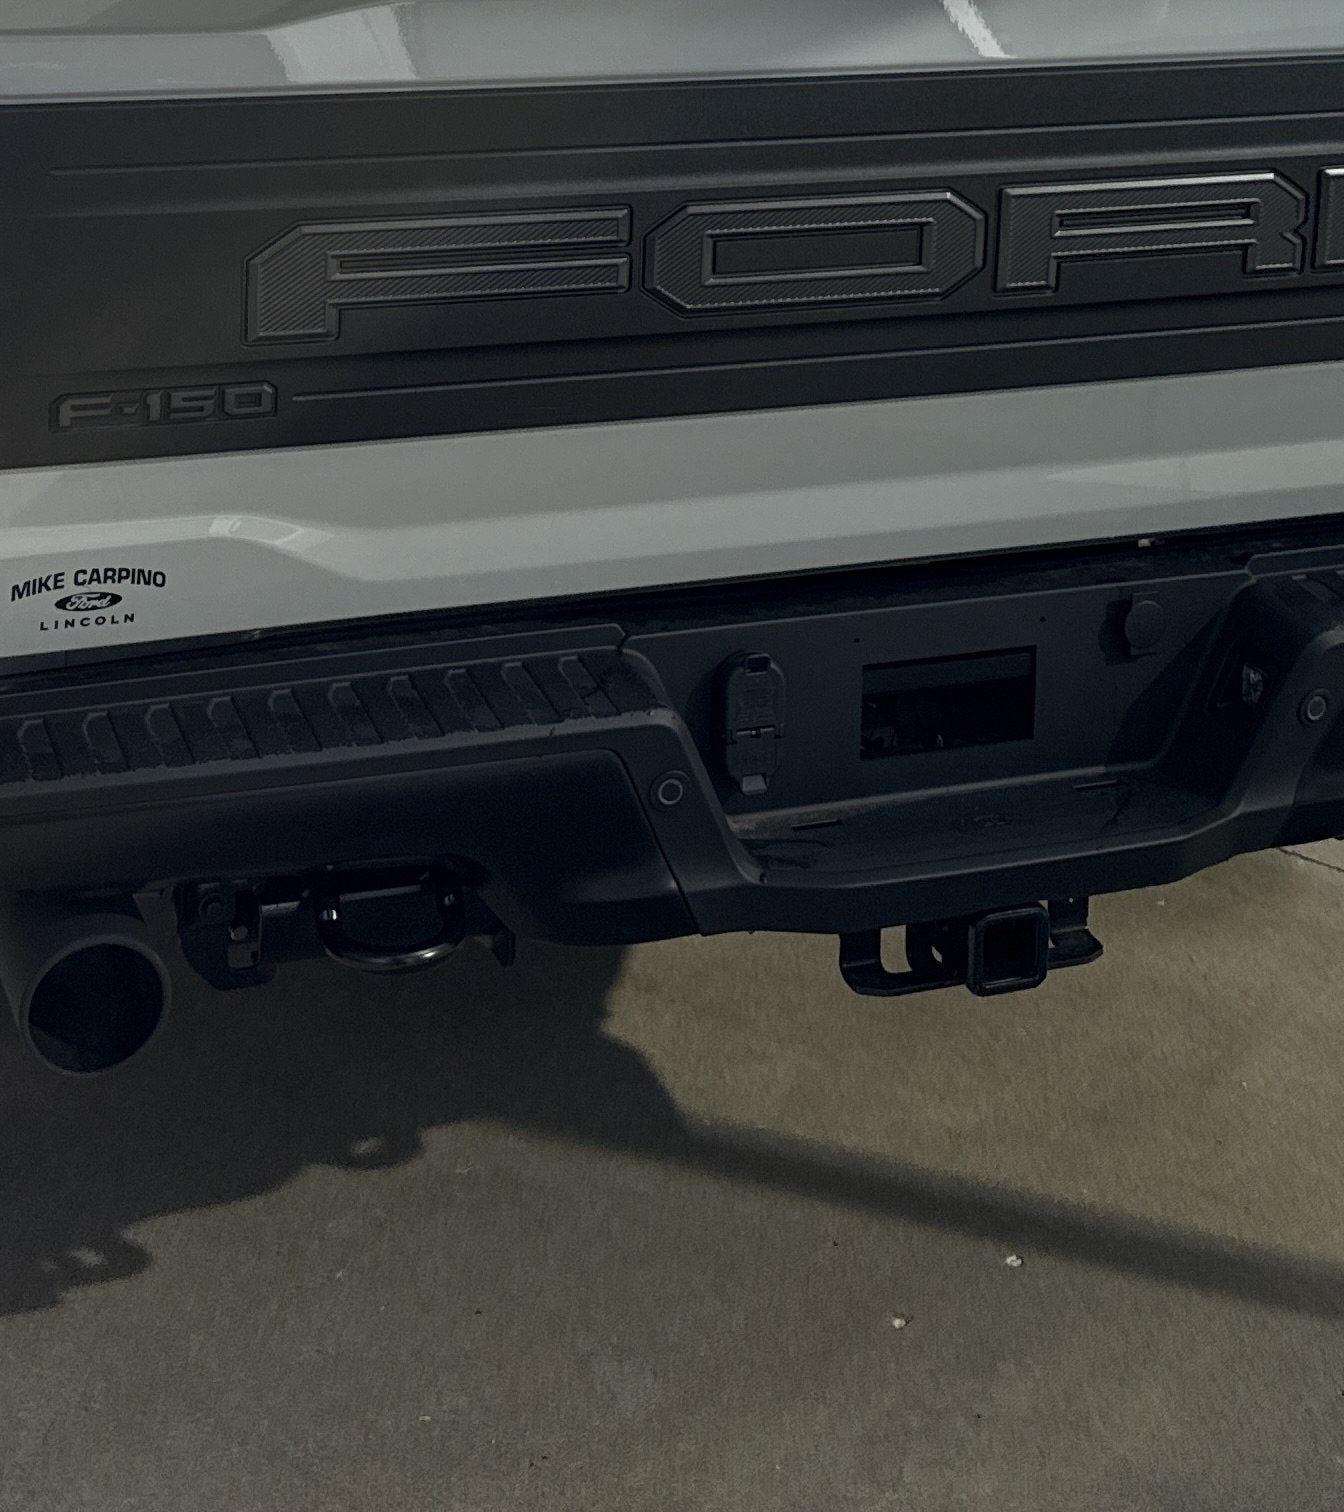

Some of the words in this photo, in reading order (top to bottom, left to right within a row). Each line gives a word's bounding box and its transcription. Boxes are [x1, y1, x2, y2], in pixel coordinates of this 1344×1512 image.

[52, 381, 276, 430] F-150
[11, 571, 65, 602] MIKE
[73, 567, 167, 588] CARPINO
[64, 592, 114, 611] Ford
[39, 613, 135, 631] LINCOLN
